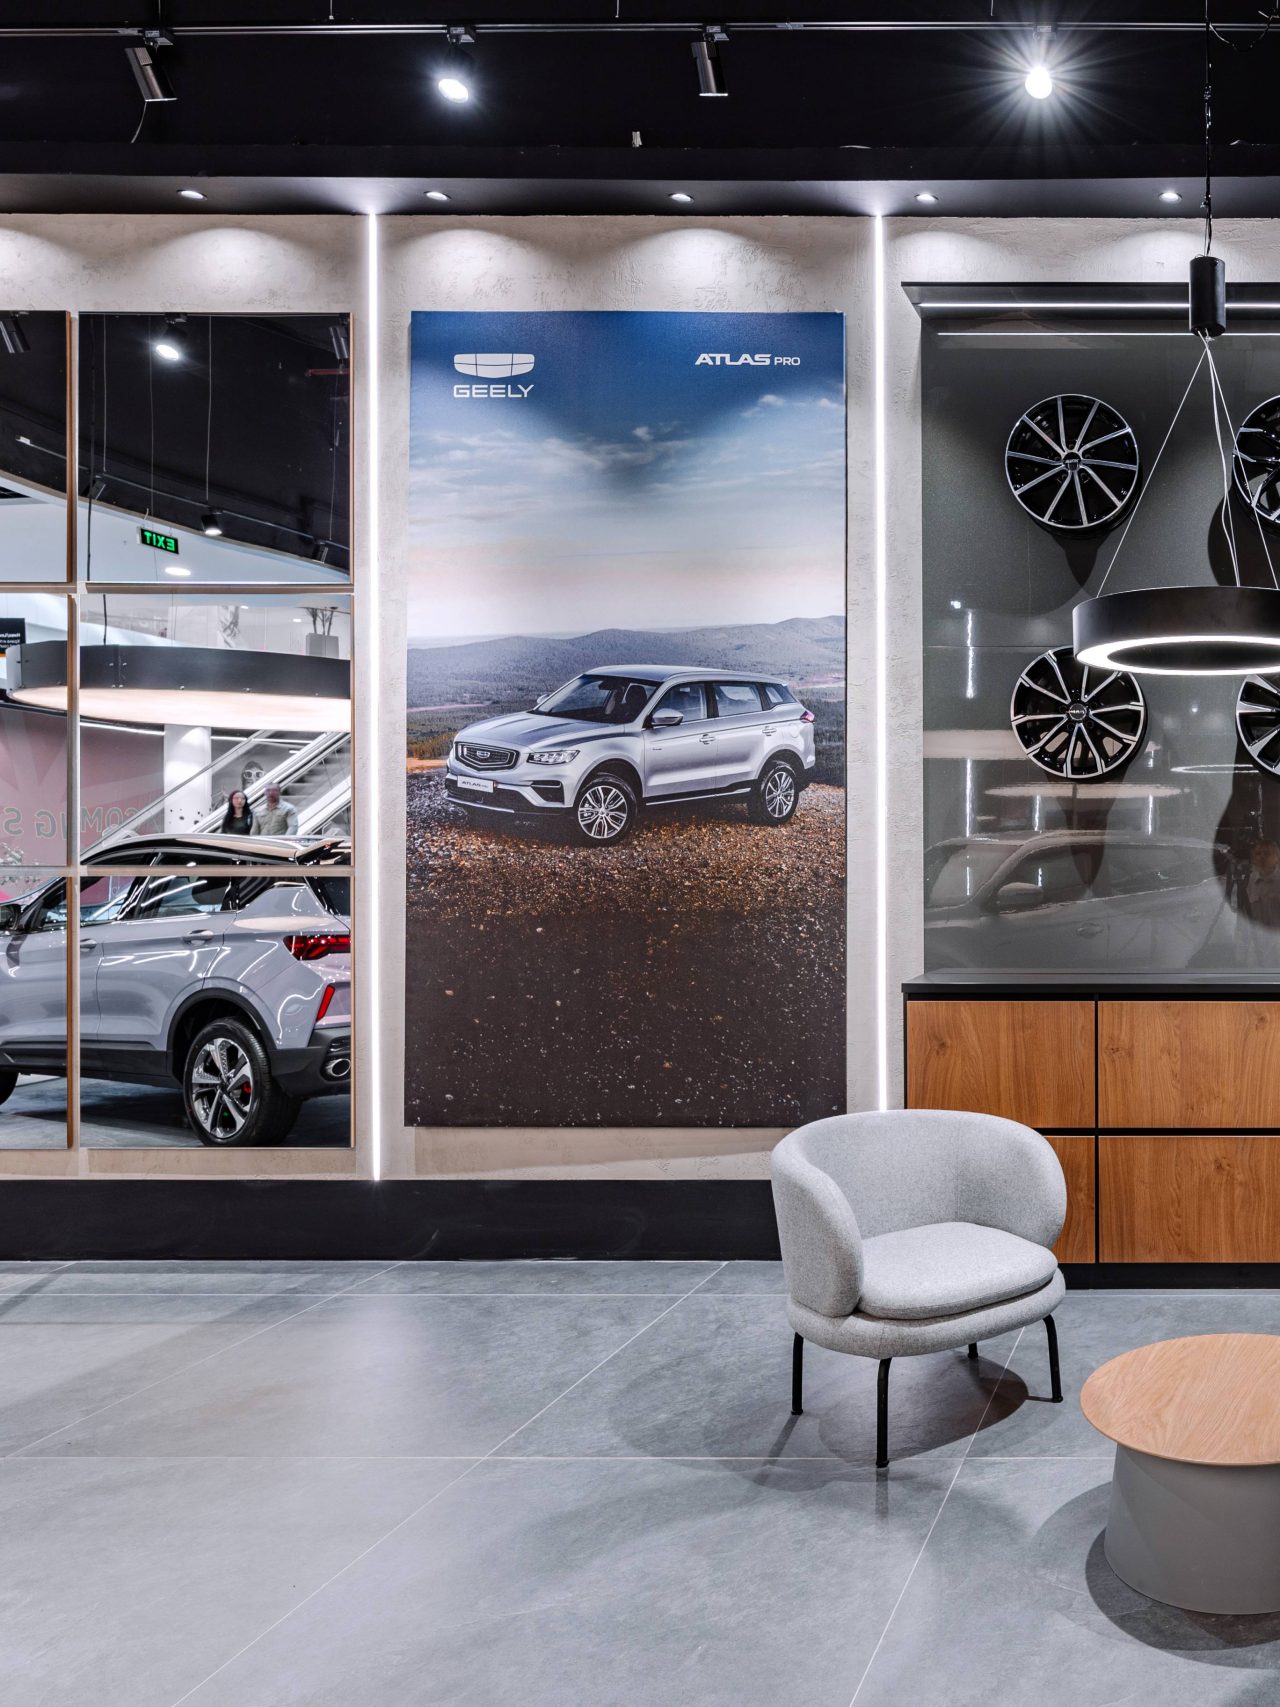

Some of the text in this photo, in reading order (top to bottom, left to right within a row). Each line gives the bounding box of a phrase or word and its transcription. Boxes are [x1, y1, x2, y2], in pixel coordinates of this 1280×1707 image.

[694, 353, 801, 366] ATLAS PRO
[453, 384, 535, 398] GEELY
